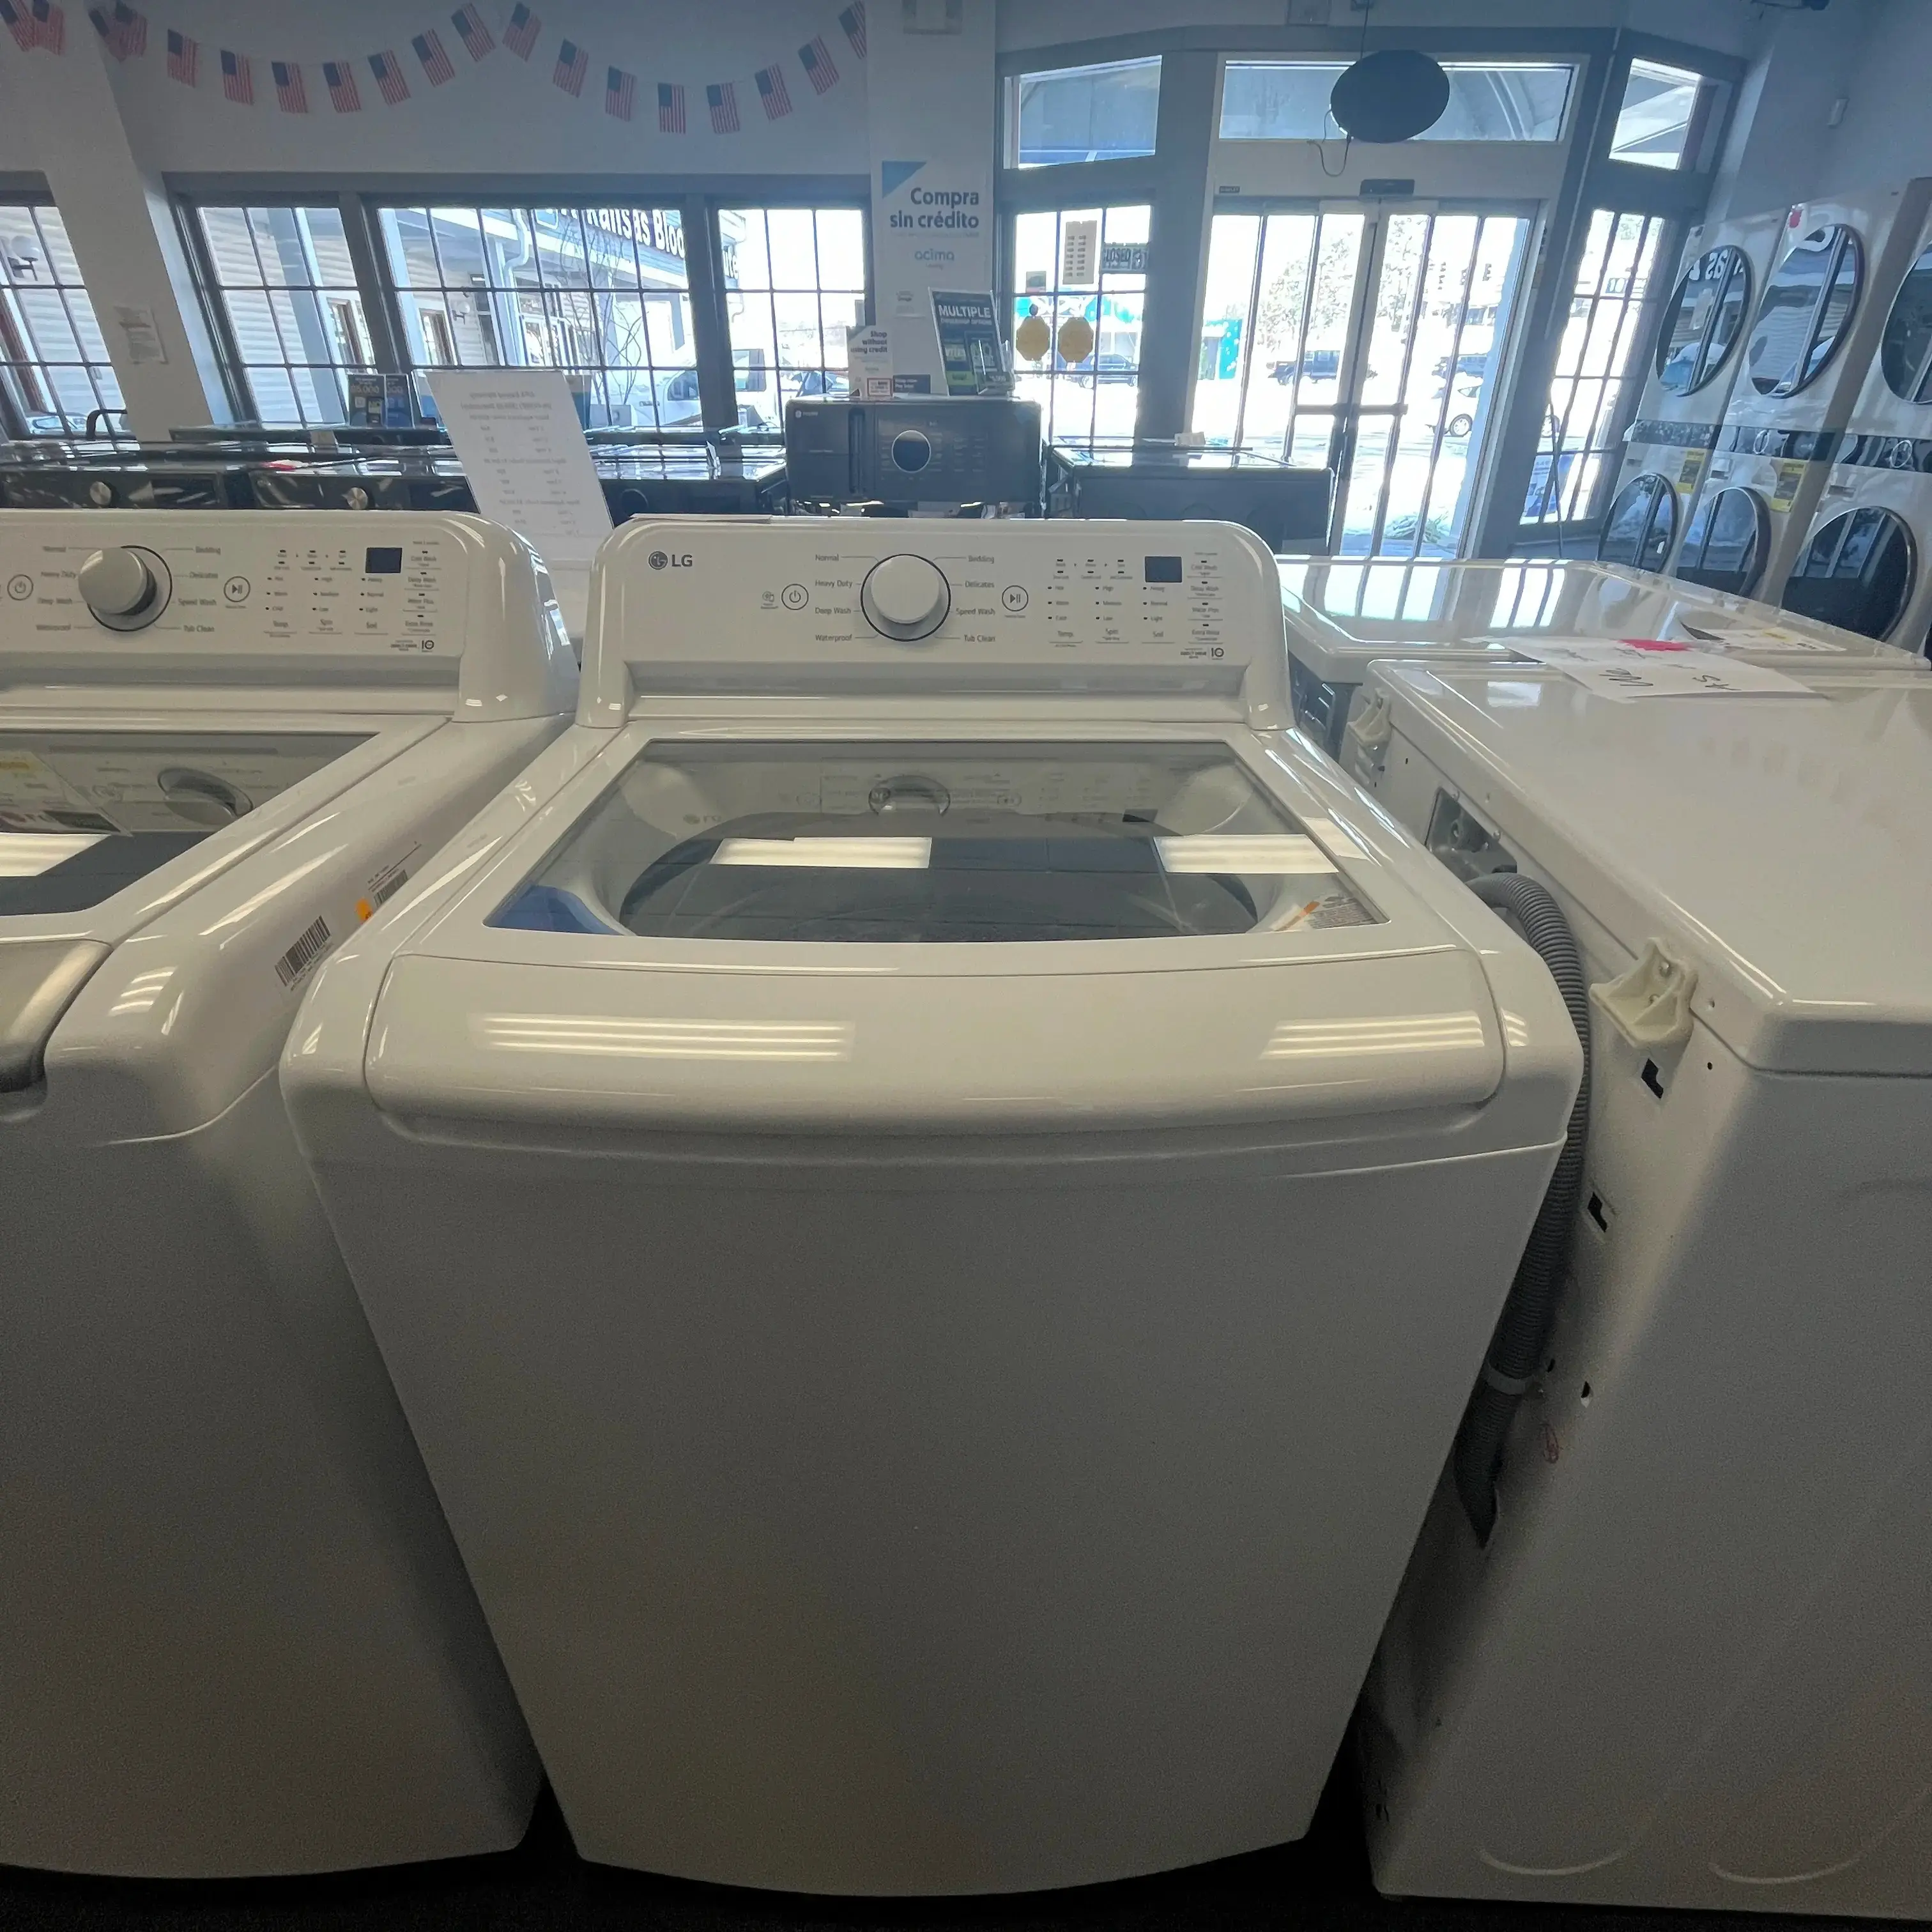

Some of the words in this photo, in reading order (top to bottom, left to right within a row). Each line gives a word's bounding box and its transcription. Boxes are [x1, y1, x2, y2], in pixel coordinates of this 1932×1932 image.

[911, 187, 979, 210] Compra
[890, 210, 913, 228] sin
[918, 211, 979, 228] crédito
[914, 249, 954, 261] acima
[939, 305, 991, 318] MULTIPLE
[672, 555, 692, 567] LG
[969, 555, 994, 564] Bedding
[837, 580, 852, 588] Duty
[422, 640, 434, 649] 10
[1211, 648, 1224, 659] 10
